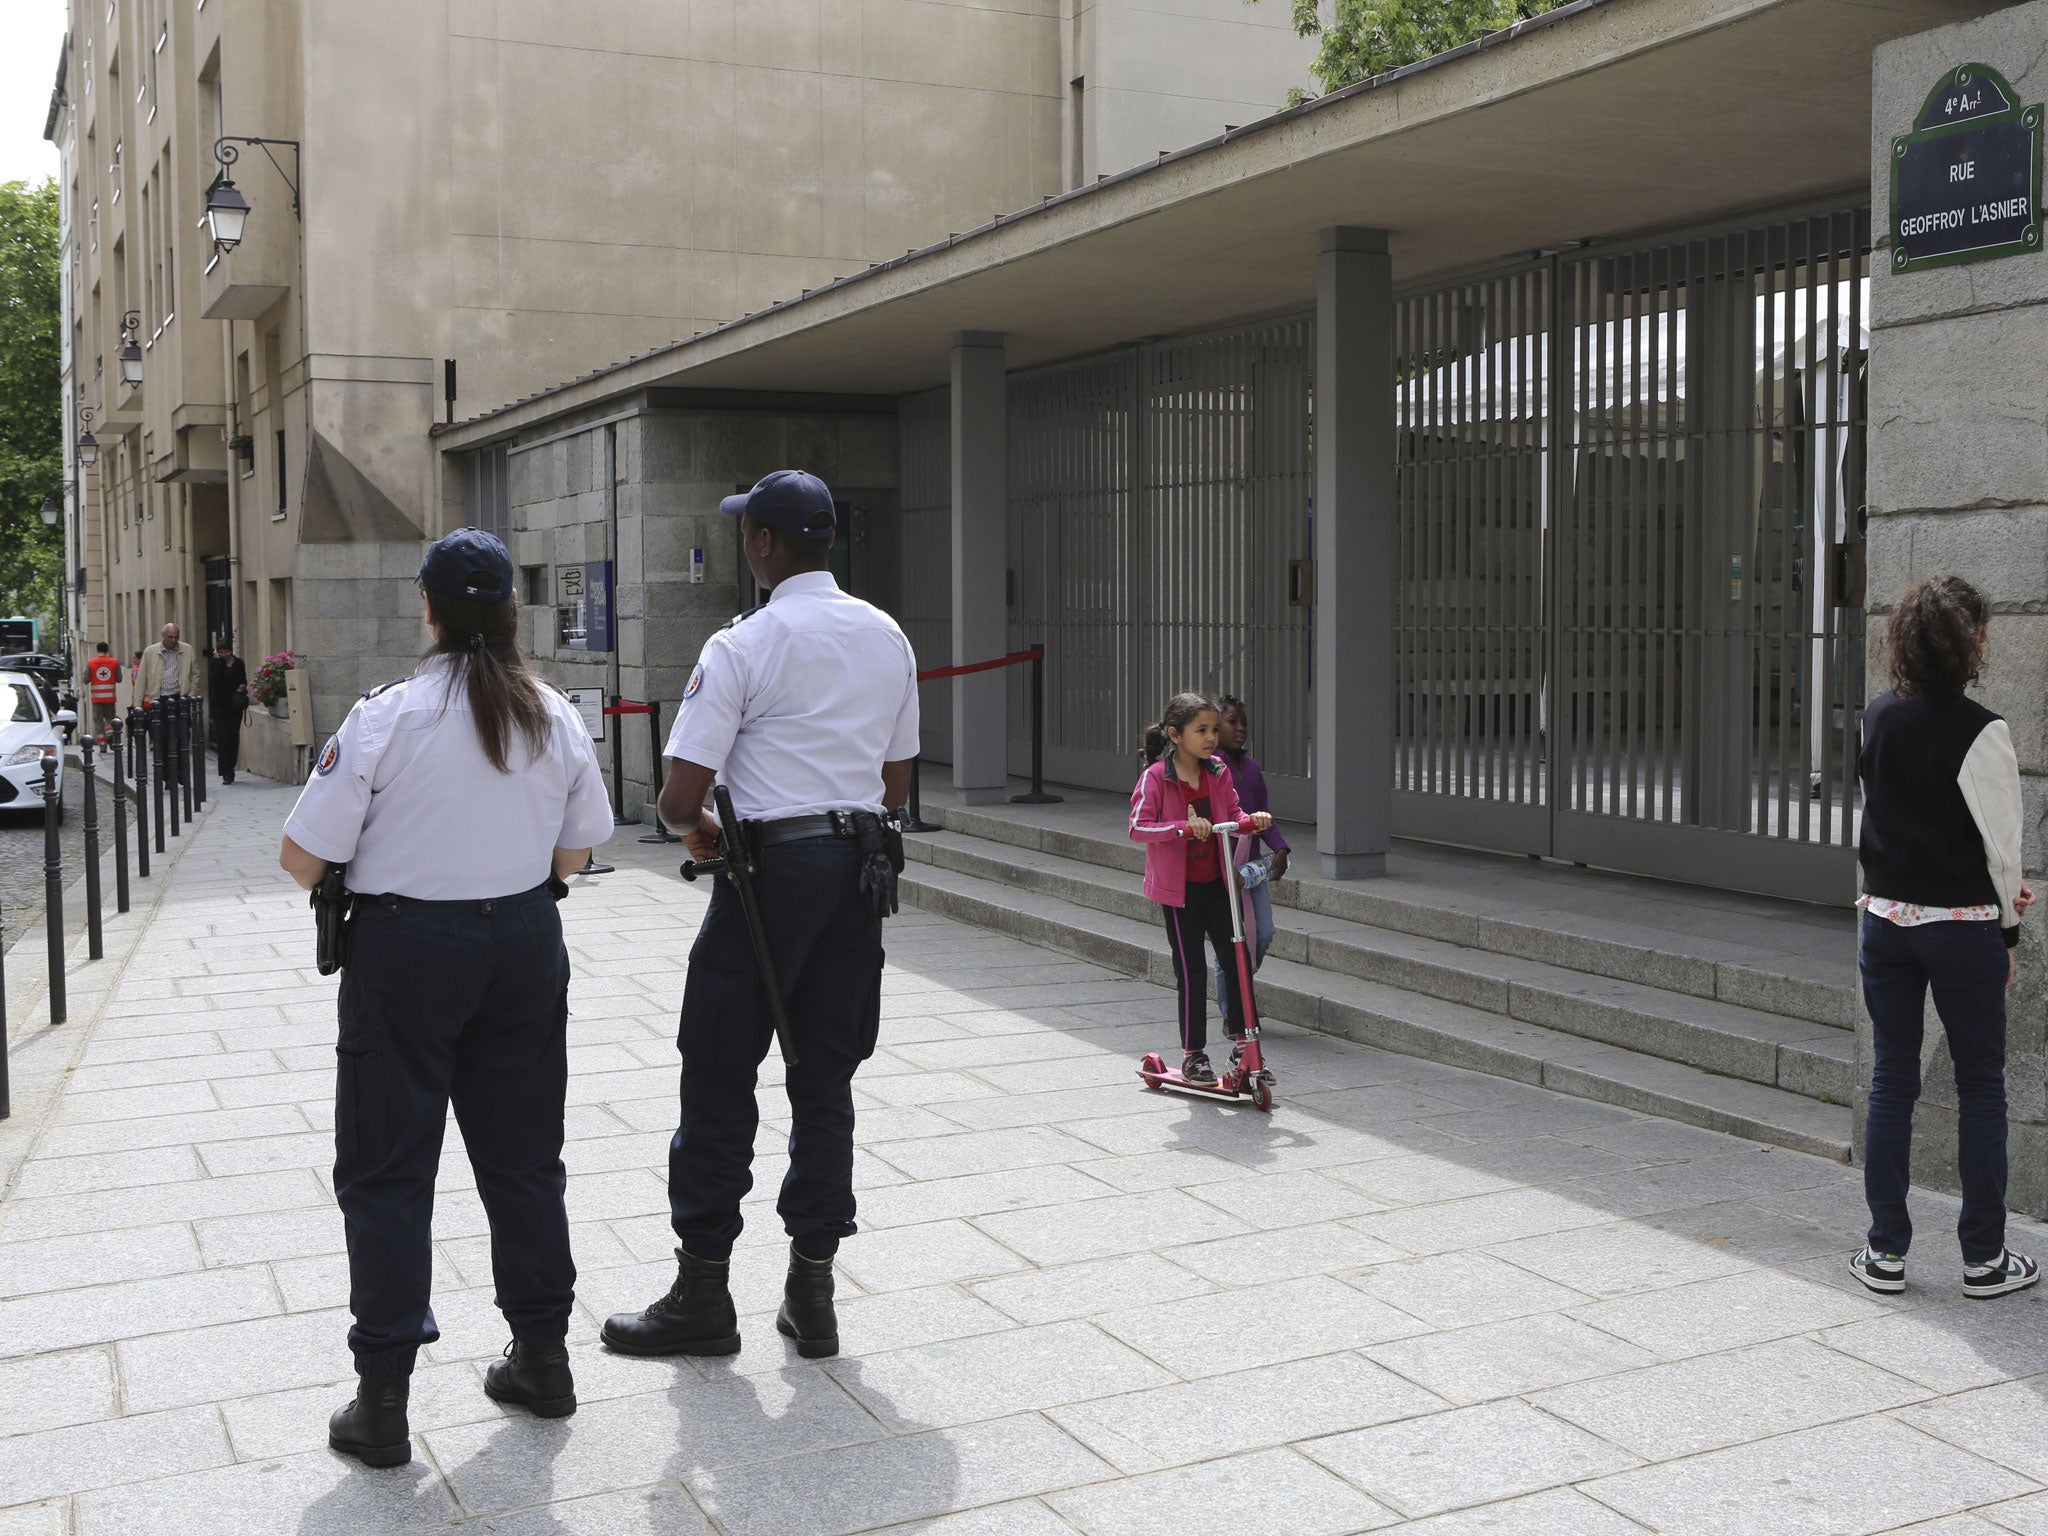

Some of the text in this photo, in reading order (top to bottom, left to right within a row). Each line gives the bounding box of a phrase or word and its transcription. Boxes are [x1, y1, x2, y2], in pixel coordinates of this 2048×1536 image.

[1944, 97, 1958, 115] 4e
[1949, 160, 1975, 183] RUE
[1900, 197, 2028, 237] GEOFFROY L'ASNIER
